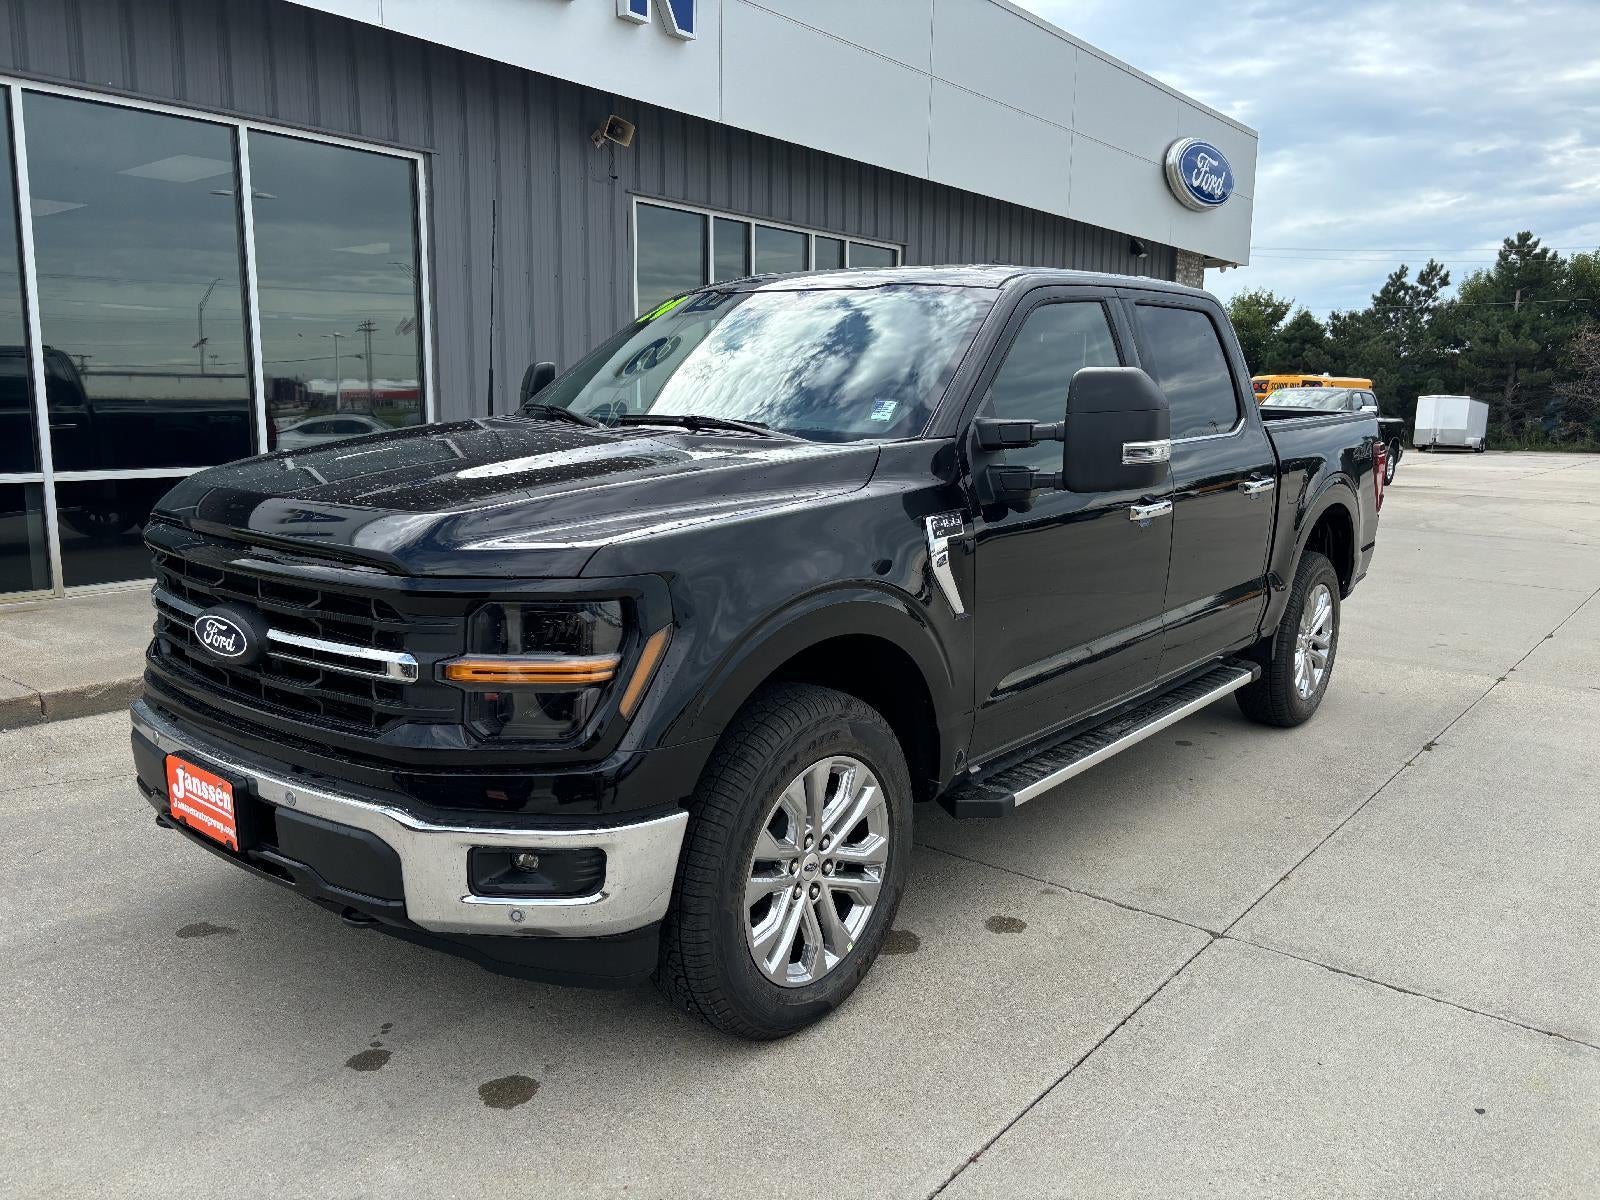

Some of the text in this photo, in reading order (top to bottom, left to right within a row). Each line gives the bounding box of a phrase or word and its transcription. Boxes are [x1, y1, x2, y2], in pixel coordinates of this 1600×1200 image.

[1191, 152, 1225, 197] Ford
[204, 620, 236, 652] Ford
[172, 767, 232, 813] Janssen
